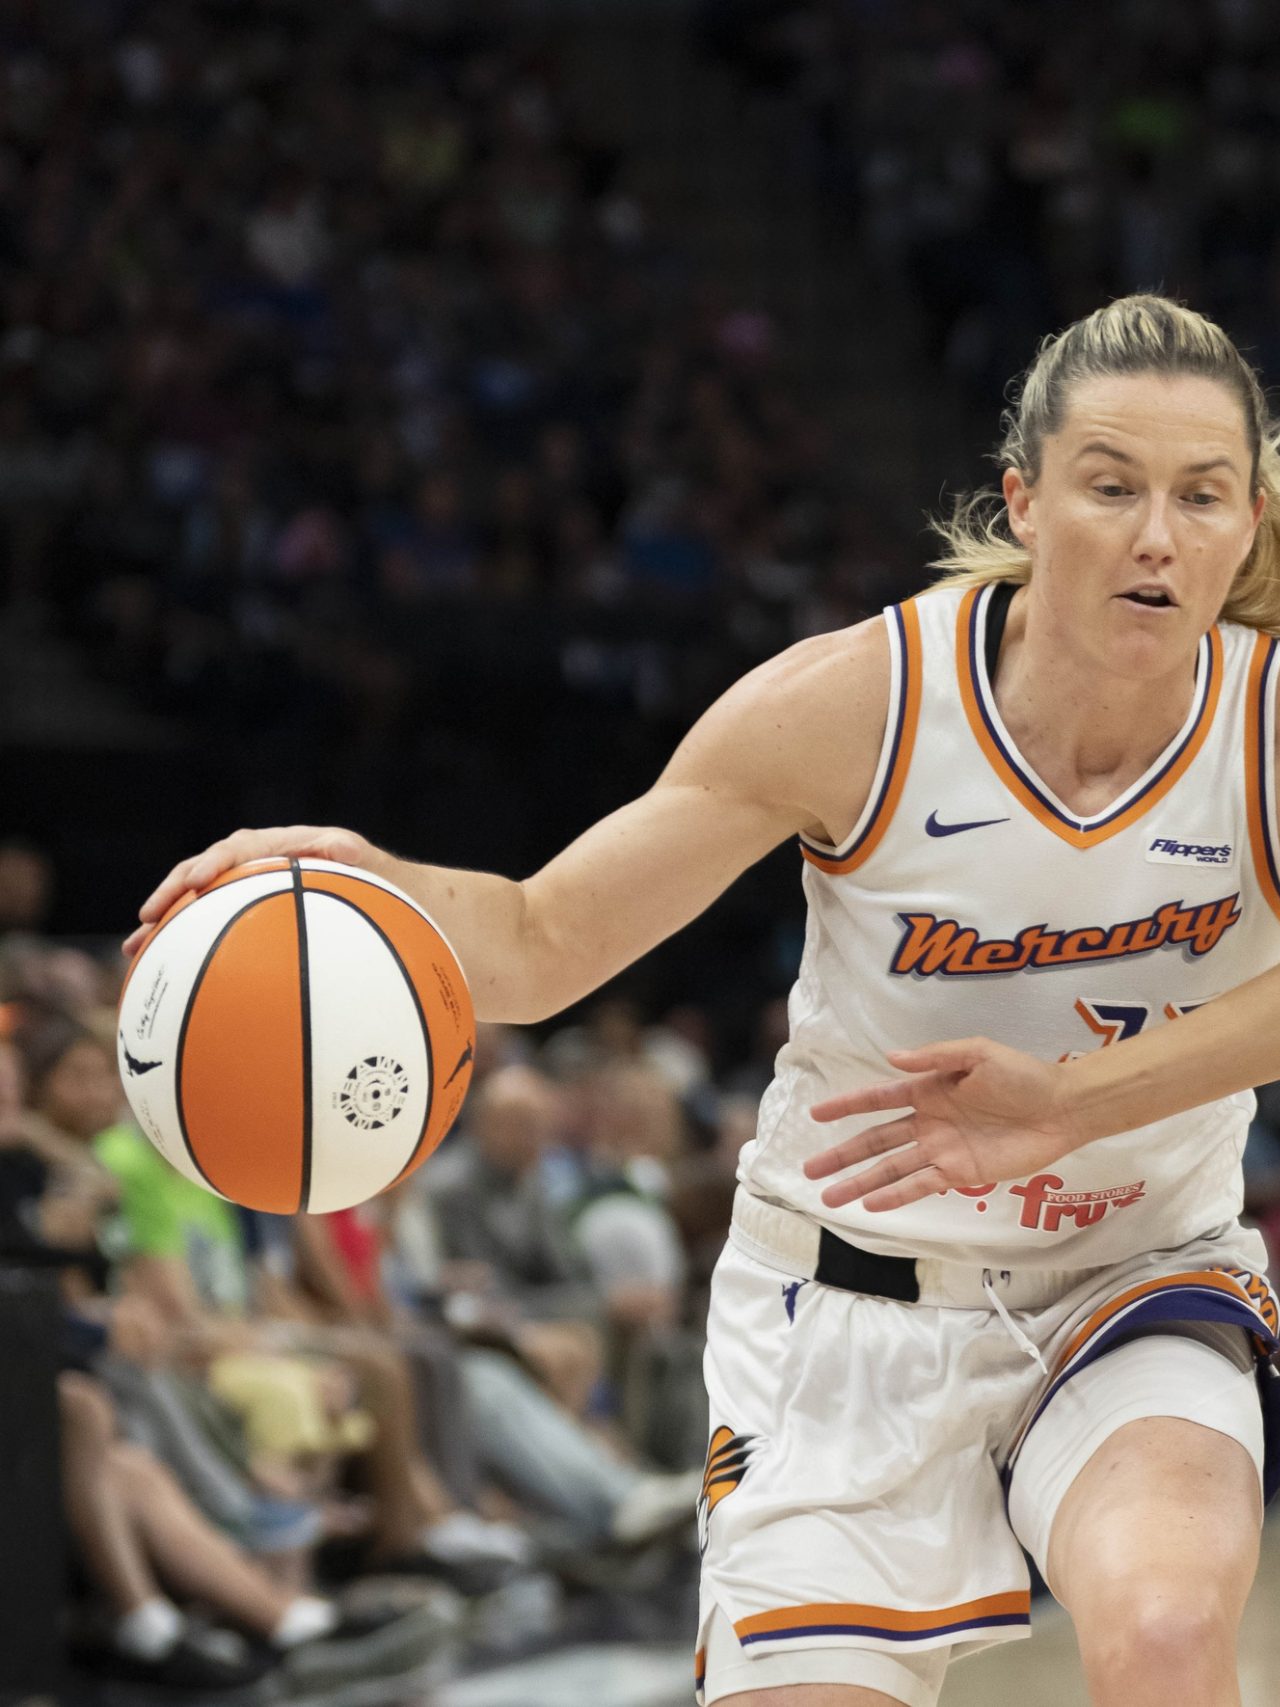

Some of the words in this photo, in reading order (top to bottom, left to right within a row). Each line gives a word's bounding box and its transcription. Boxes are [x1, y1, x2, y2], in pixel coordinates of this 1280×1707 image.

[1149, 838, 1232, 857] Flipper's
[1196, 855, 1229, 864] WORLD
[889, 891, 1241, 979] Mercury
[1047, 1192, 1086, 1203] FOOD
[1090, 1184, 1141, 1200] STORES
